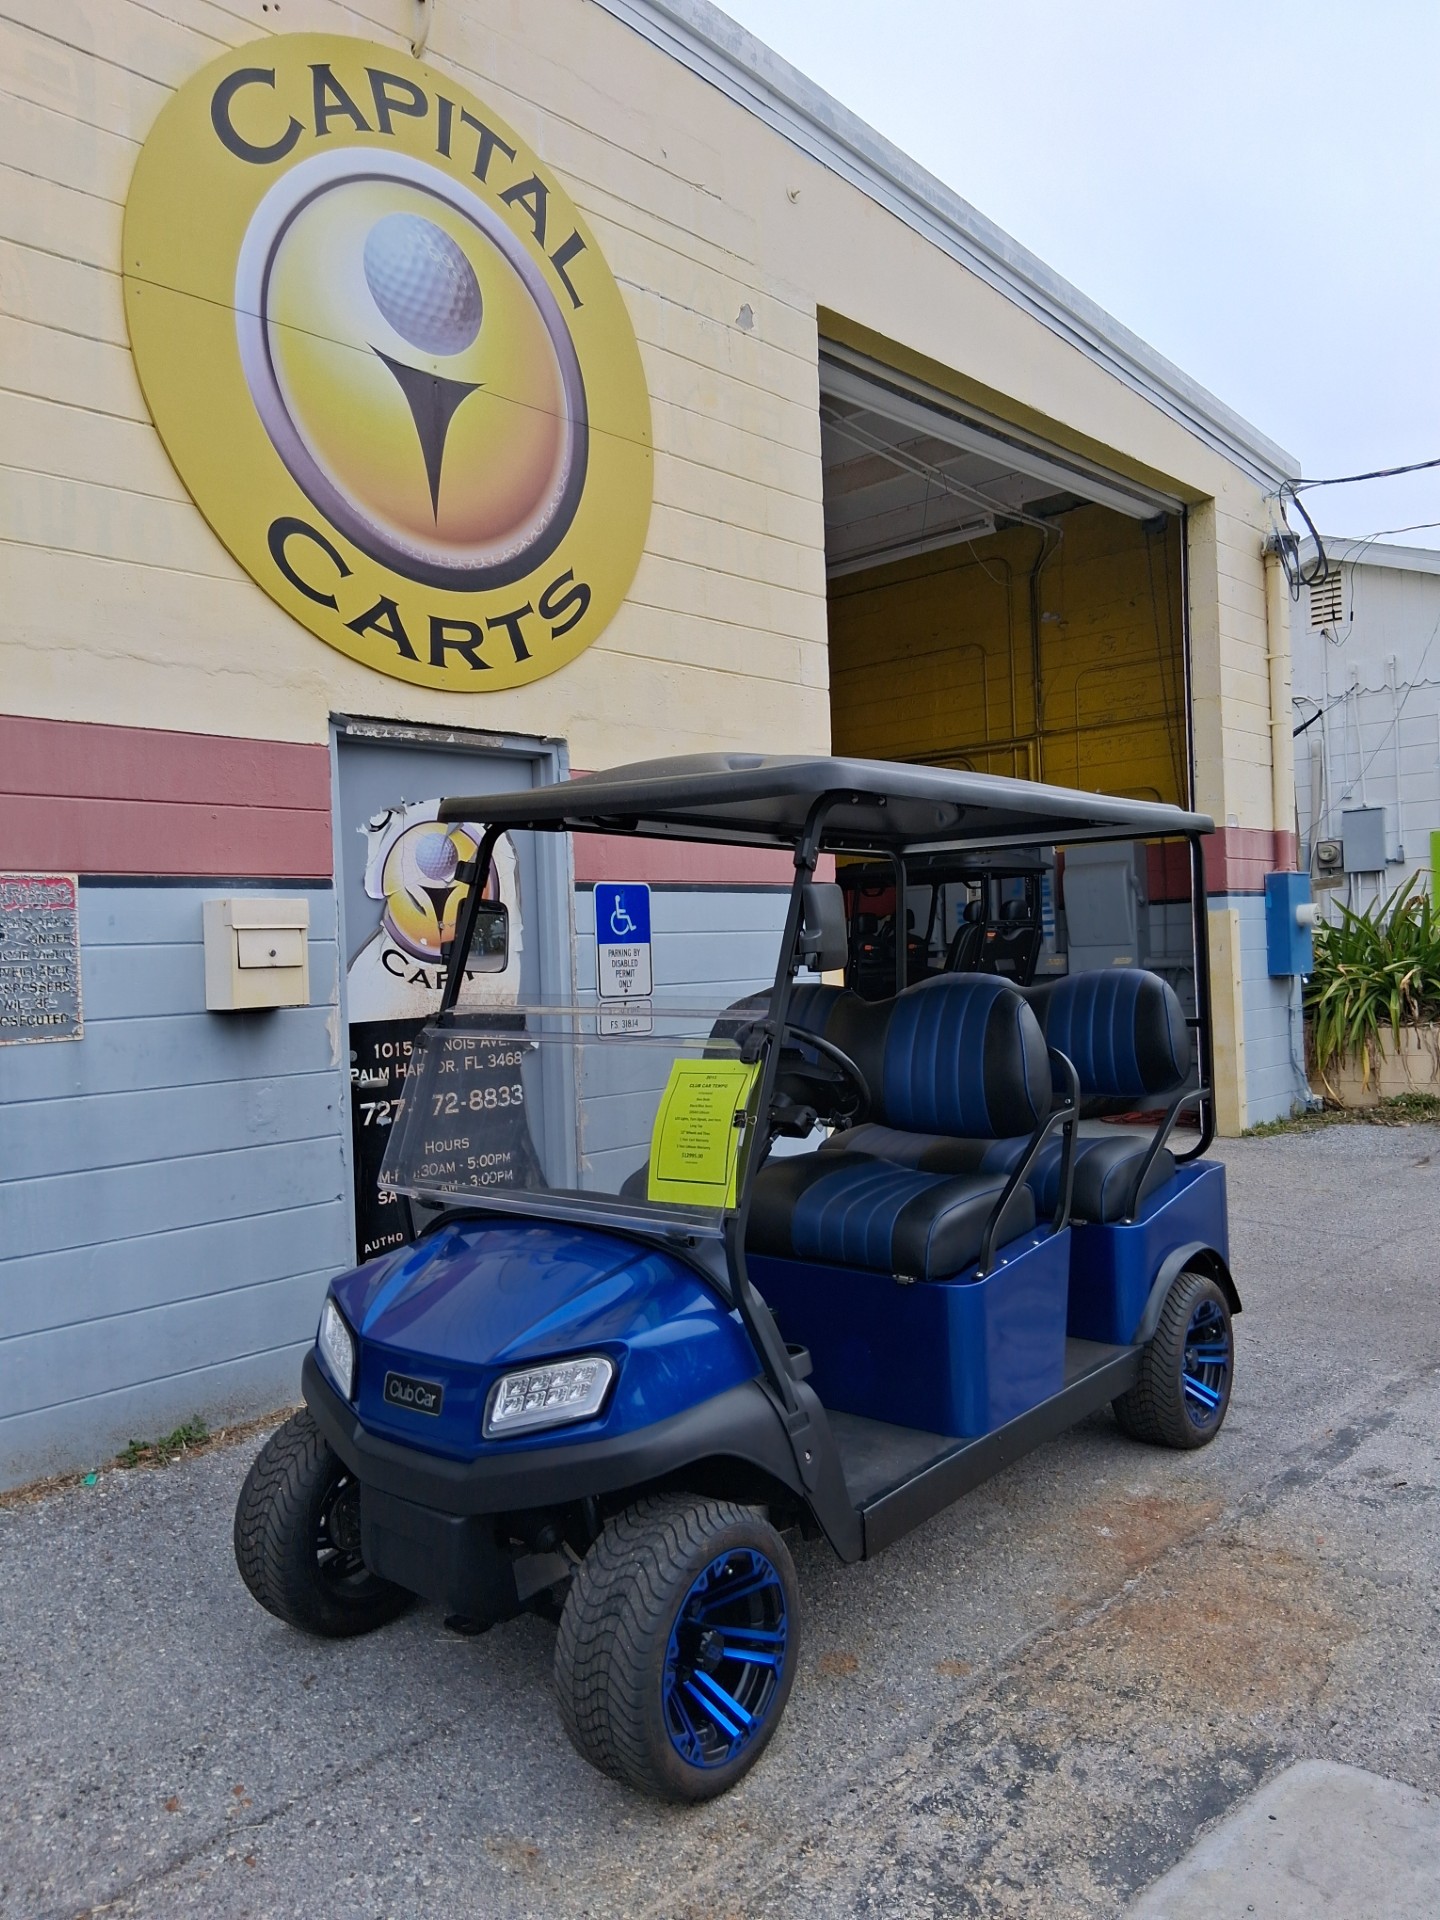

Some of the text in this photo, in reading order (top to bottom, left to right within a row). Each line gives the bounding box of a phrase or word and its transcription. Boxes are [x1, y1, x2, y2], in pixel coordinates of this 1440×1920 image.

[210, 63, 591, 311] CAPITAL
[266, 516, 593, 672] CARTS
[608, 948, 641, 958] PARKING BY
[611, 959, 639, 969] DISABLED
[615, 968, 636, 979] PERMIT
[618, 980, 633, 988] ONLY
[374, 1041, 413, 1059] 1015
[350, 1066, 390, 1081] PALM
[464, 1055, 484, 1071] FL
[424, 1137, 470, 1155] HOURS
[467, 1152, 511, 1170] 5:00PM
[470, 1170, 513, 1187] 3:00PM
[390, 1380, 437, 1408] Club Car
